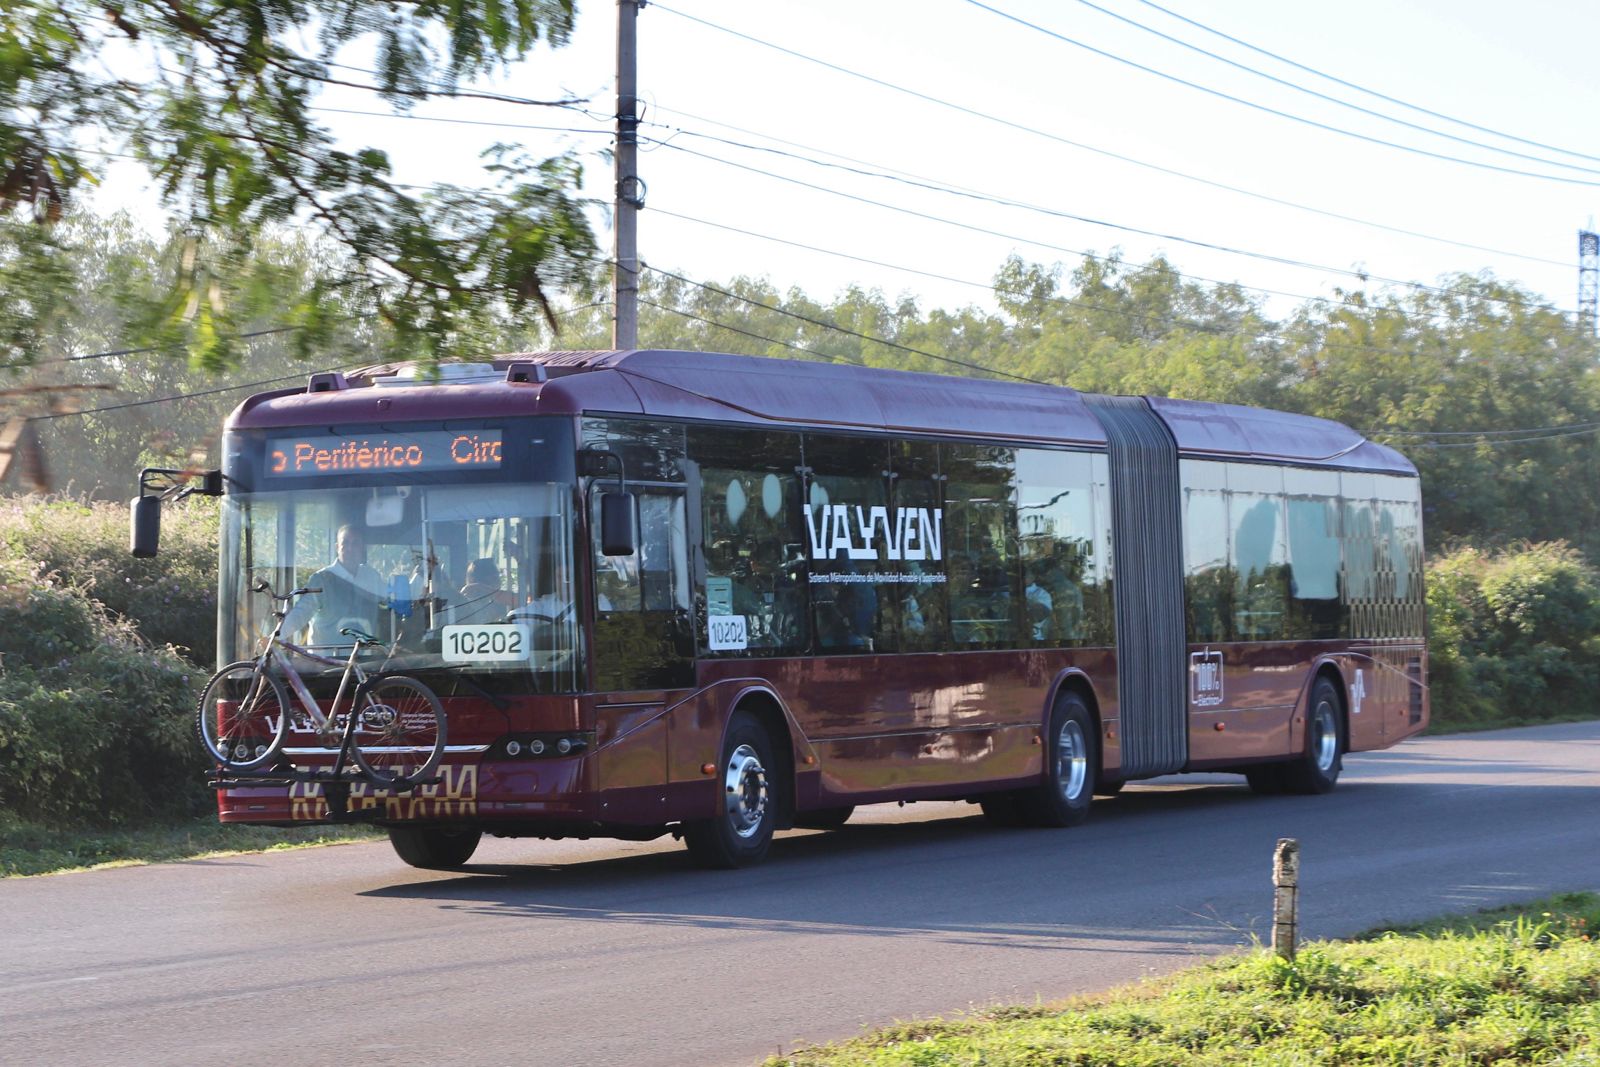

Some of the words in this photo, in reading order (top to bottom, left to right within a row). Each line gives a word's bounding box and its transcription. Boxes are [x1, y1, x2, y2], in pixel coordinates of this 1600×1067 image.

[295, 440, 423, 471] Periférico
[803, 503, 942, 561] VAYVEN
[867, 572, 874, 583] de
[449, 631, 522, 654] 10202
[711, 622, 744, 644] 10202
